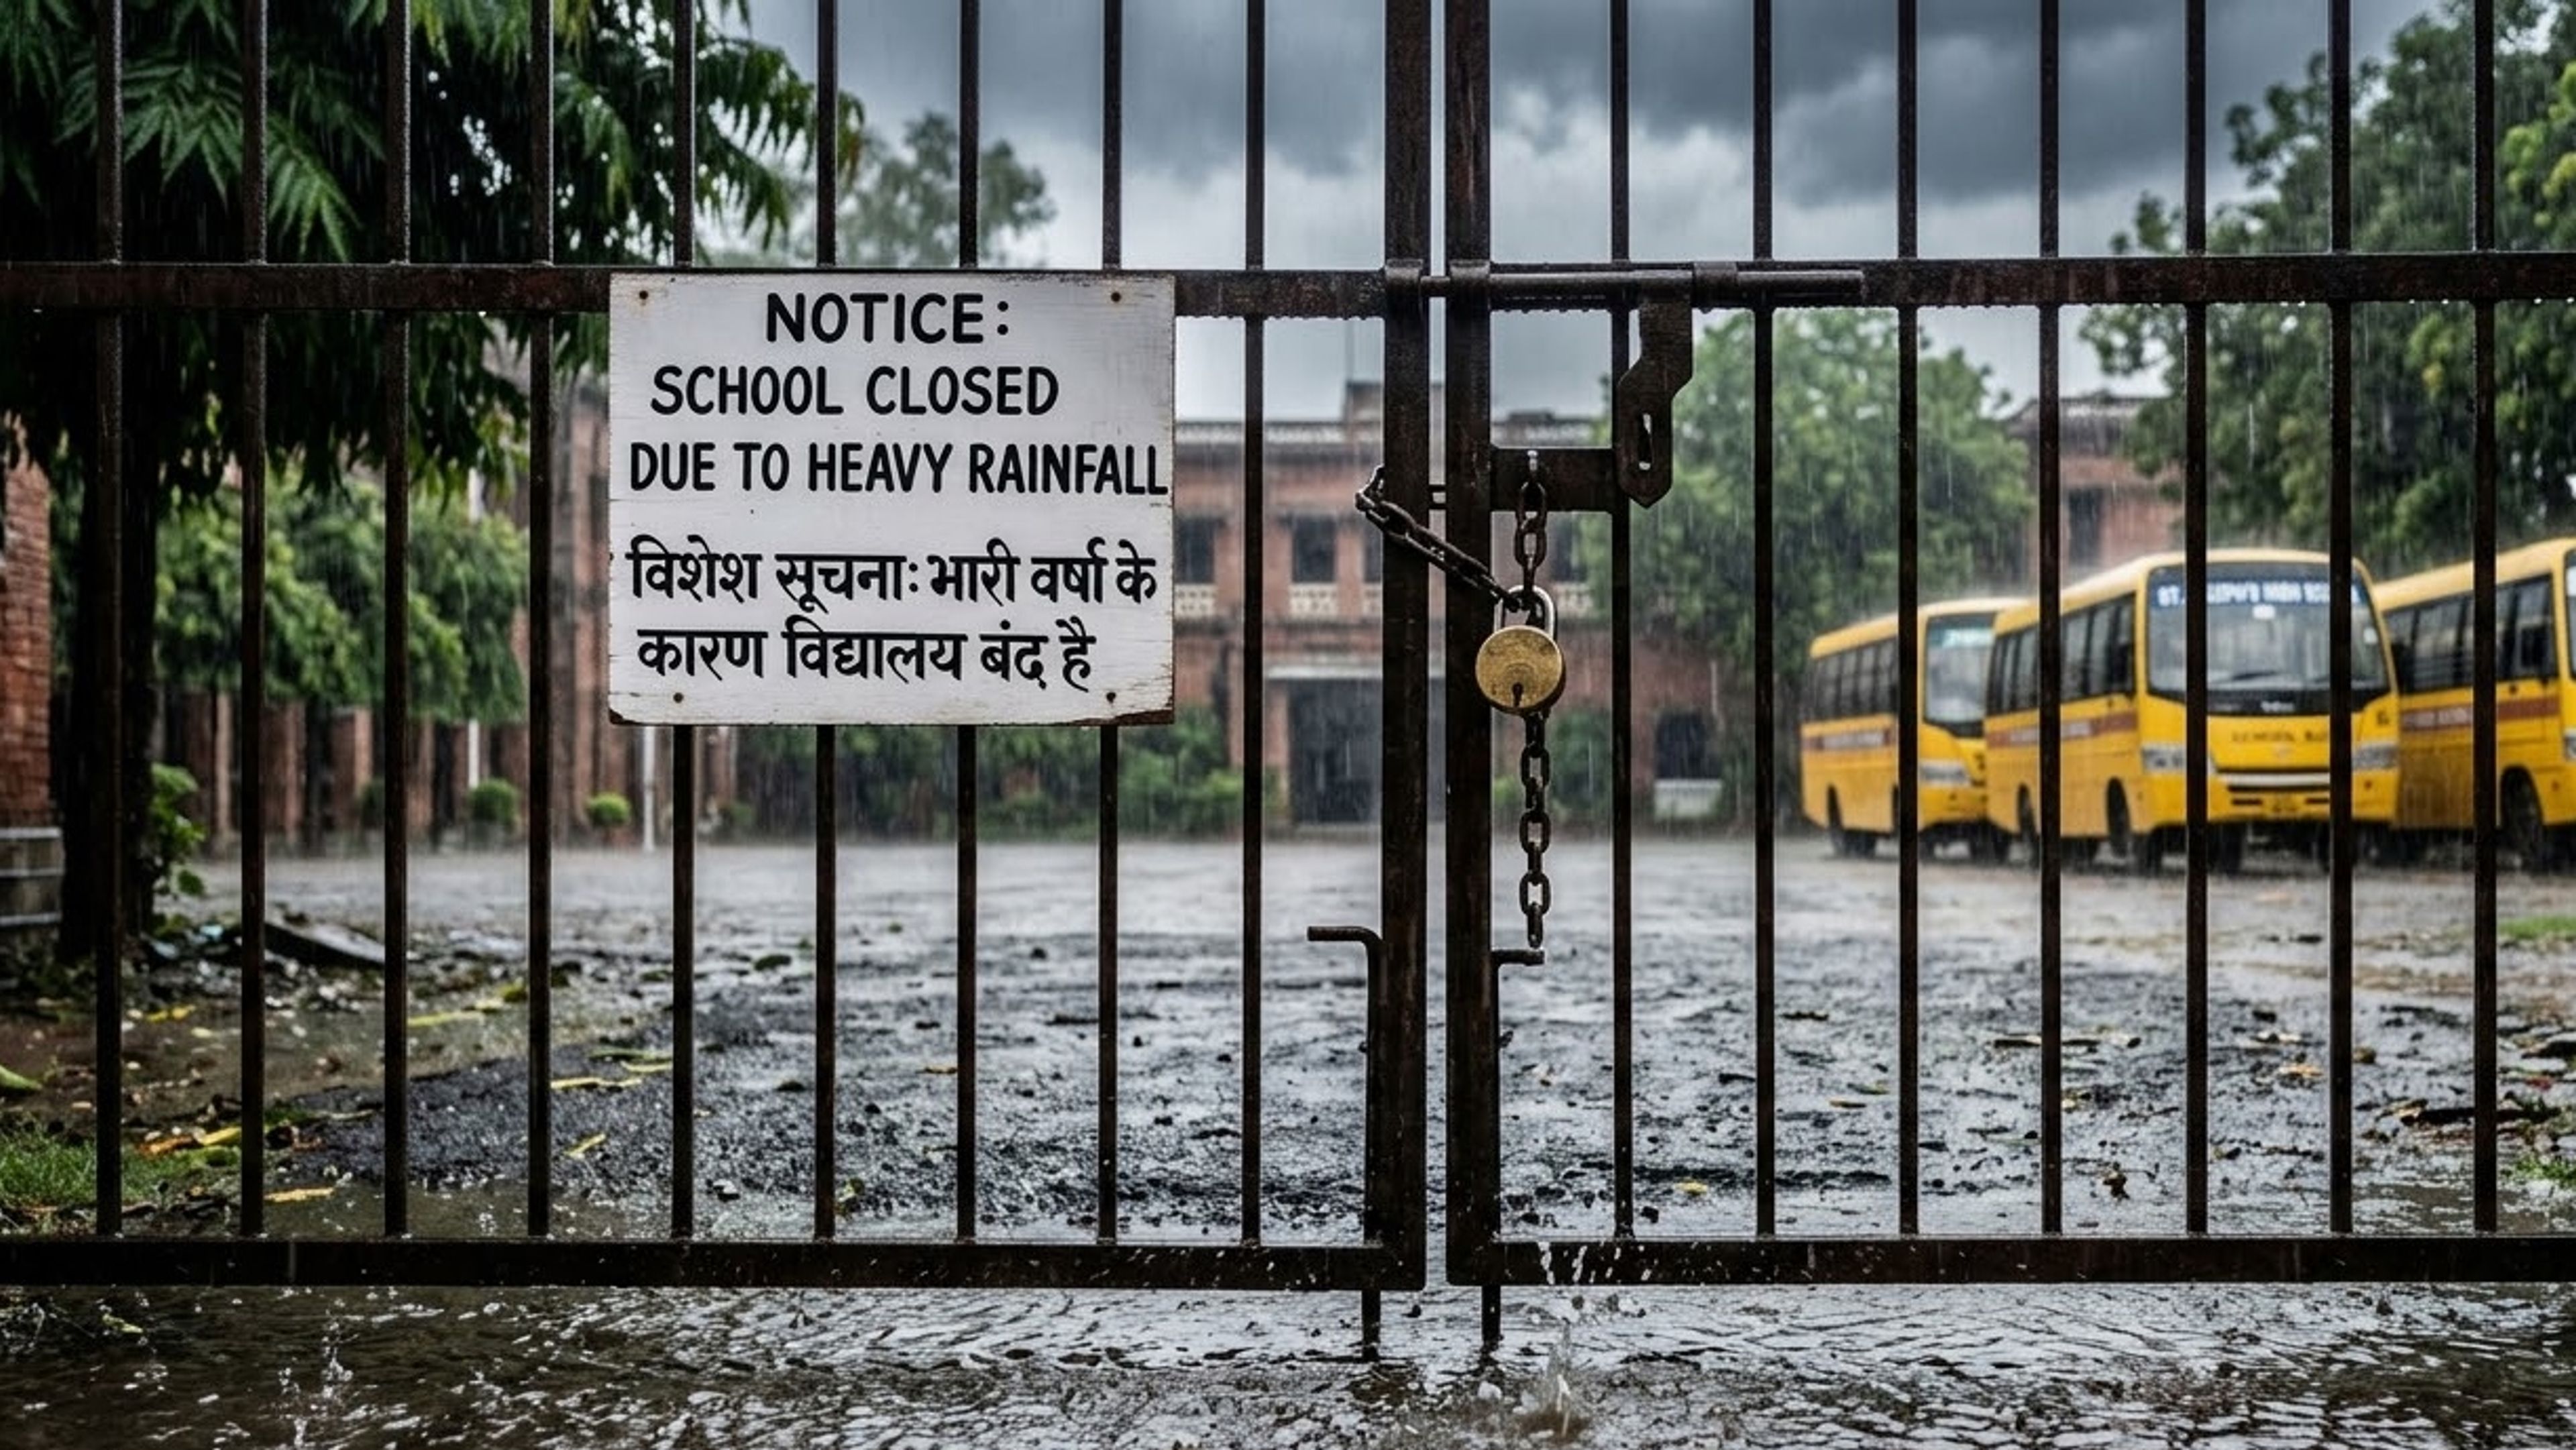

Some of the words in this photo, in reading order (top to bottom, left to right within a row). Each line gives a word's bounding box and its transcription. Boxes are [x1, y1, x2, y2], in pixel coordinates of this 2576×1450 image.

[765, 292, 1010, 345] NOTICE:
[649, 365, 845, 416] SCHOOL
[865, 365, 1060, 416] CLOSED
[630, 441, 716, 492] DUE
[732, 441, 790, 492] TO
[807, 441, 954, 494] HEAVY
[968, 443, 1169, 496] RAINFALL
[624, 533, 763, 604] विशेश
[926, 537, 1022, 608] भारी
[1030, 535, 1110, 604] वर्षा
[1114, 538, 1159, 605] के
[636, 628, 769, 682] कारण
[780, 614, 969, 684] विद्यालय
[978, 618, 1051, 691] बंद
[1055, 614, 1097, 693] है
